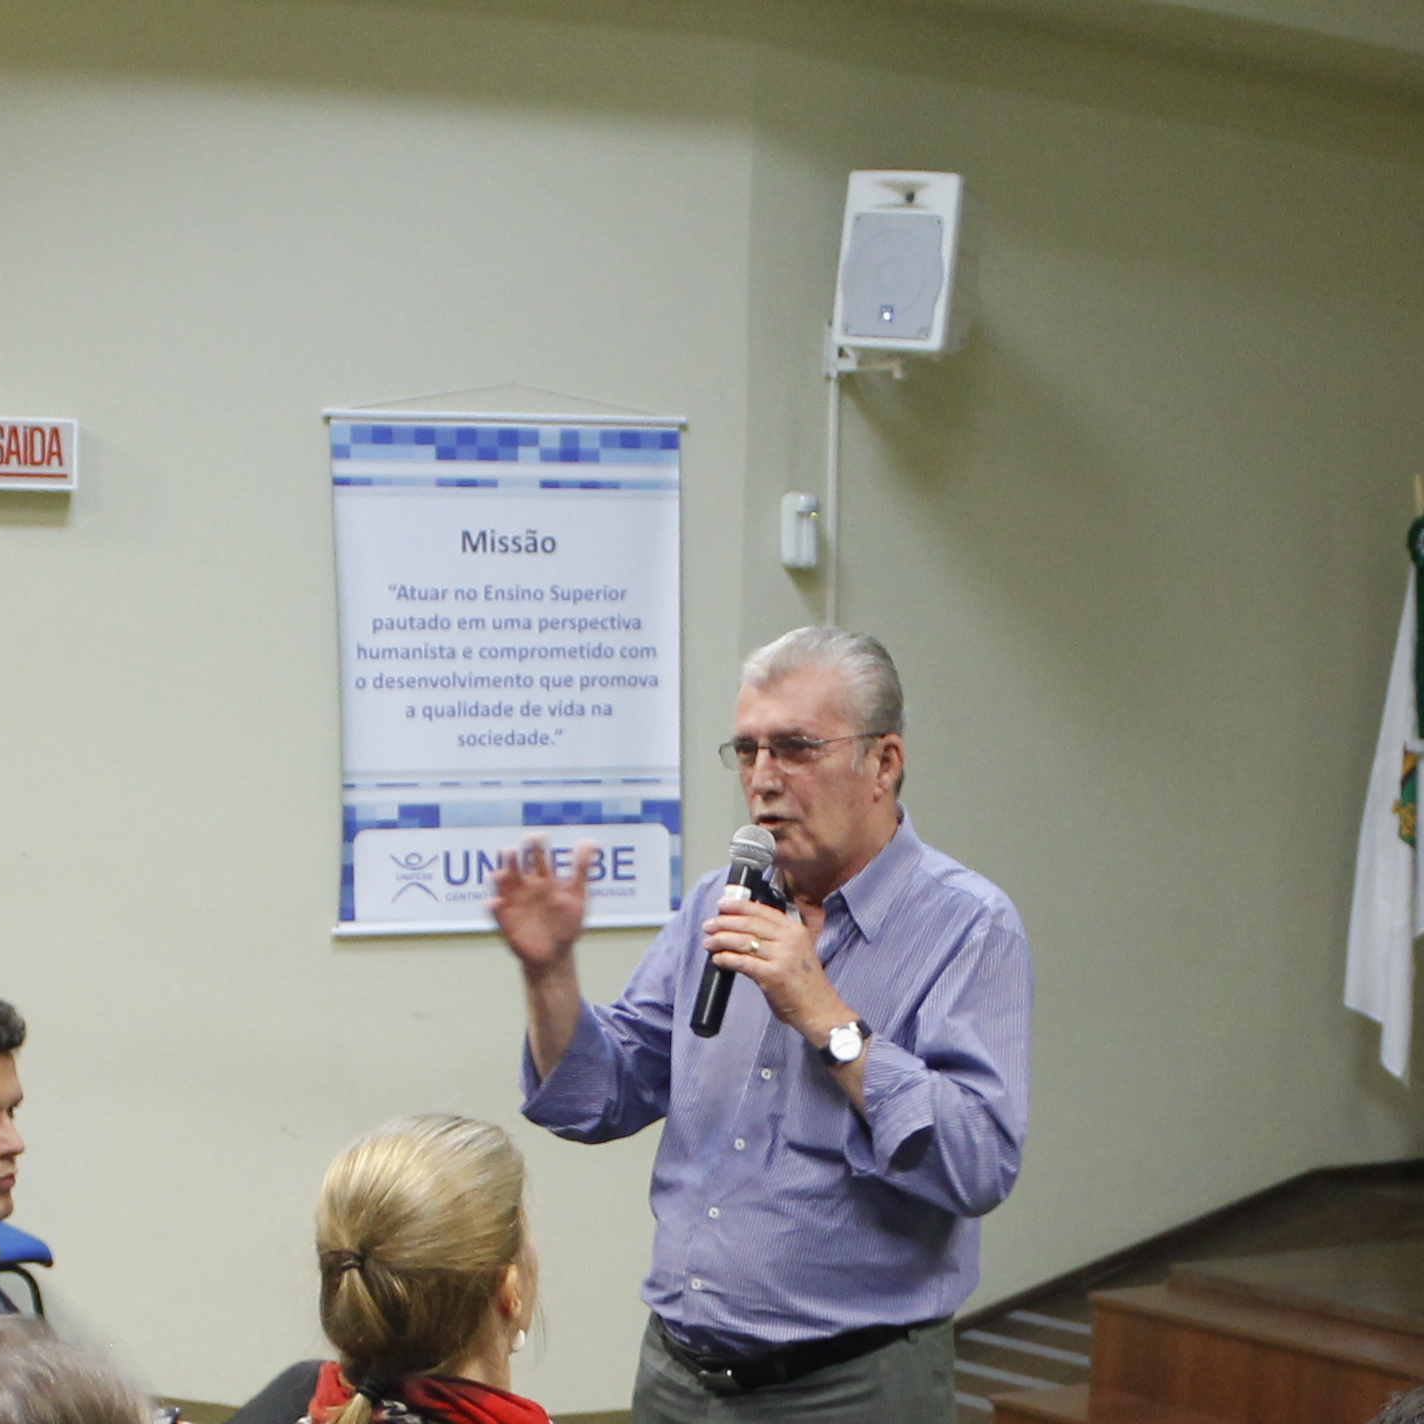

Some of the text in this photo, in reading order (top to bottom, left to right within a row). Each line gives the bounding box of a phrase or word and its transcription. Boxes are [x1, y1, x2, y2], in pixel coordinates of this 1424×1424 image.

[460, 529, 557, 554] Missão
[454, 588, 478, 602] no
[484, 584, 544, 602] Ensino
[550, 584, 627, 607] Superior
[371, 614, 642, 636] pautado em uma perspectiva
[356, 642, 657, 665] humanista e comprometido com
[355, 671, 659, 694] o desenvolvimento que promova
[406, 700, 612, 723] a qualidade de vida na
